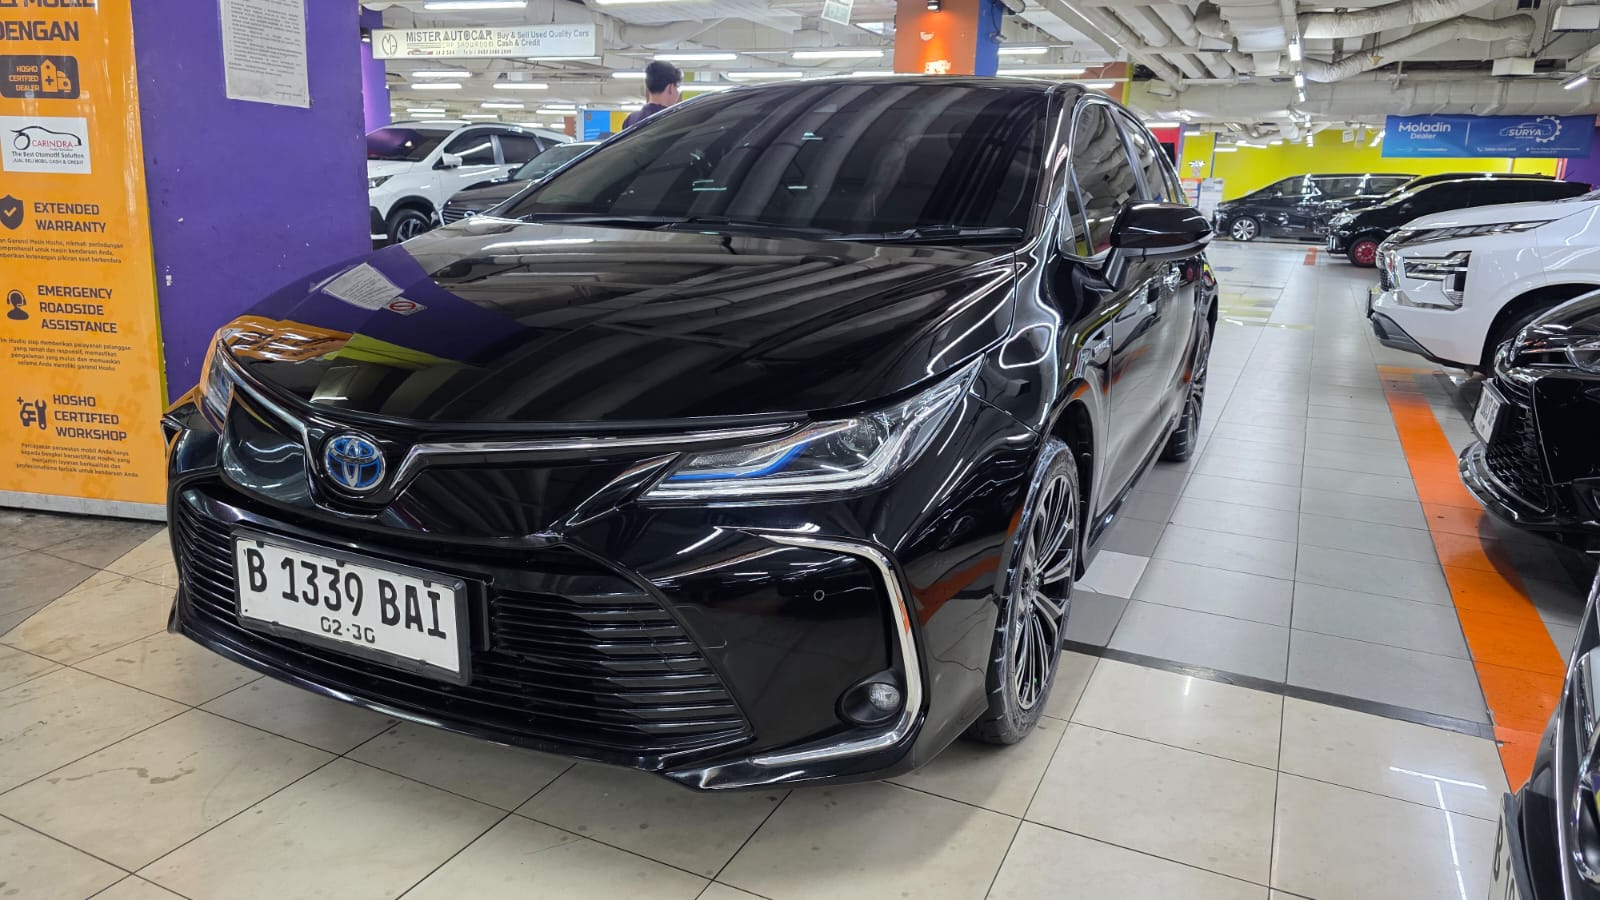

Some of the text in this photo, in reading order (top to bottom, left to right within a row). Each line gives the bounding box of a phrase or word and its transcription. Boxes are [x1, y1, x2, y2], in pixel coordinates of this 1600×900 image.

[406, 30, 493, 42] MISTER AUTOCAR
[497, 29, 589, 40] Buy & Sell Used Quality Cars
[497, 38, 541, 47] Cash & Credit
[16, 65, 38, 73] HOSHO
[9, 74, 39, 82] CERTIFIED
[16, 84, 40, 92] DEALER
[1398, 122, 1451, 133] Moladin
[1508, 128, 1543, 137] SURYA
[1410, 132, 1438, 140] Dealer
[32, 139, 74, 149] CARINDRA
[34, 202, 100, 216] EXTENDED
[36, 220, 106, 234] WARRANTY
[38, 285, 113, 300] EMERGENCY
[40, 302, 104, 316] ROADSIDE
[42, 319, 118, 333] ASSISTANCE
[53, 394, 97, 407] HOSHO
[54, 411, 120, 425] CERTIFIED
[56, 427, 127, 442] WORKSHOP
[246, 547, 447, 640] B 1339 BAI
